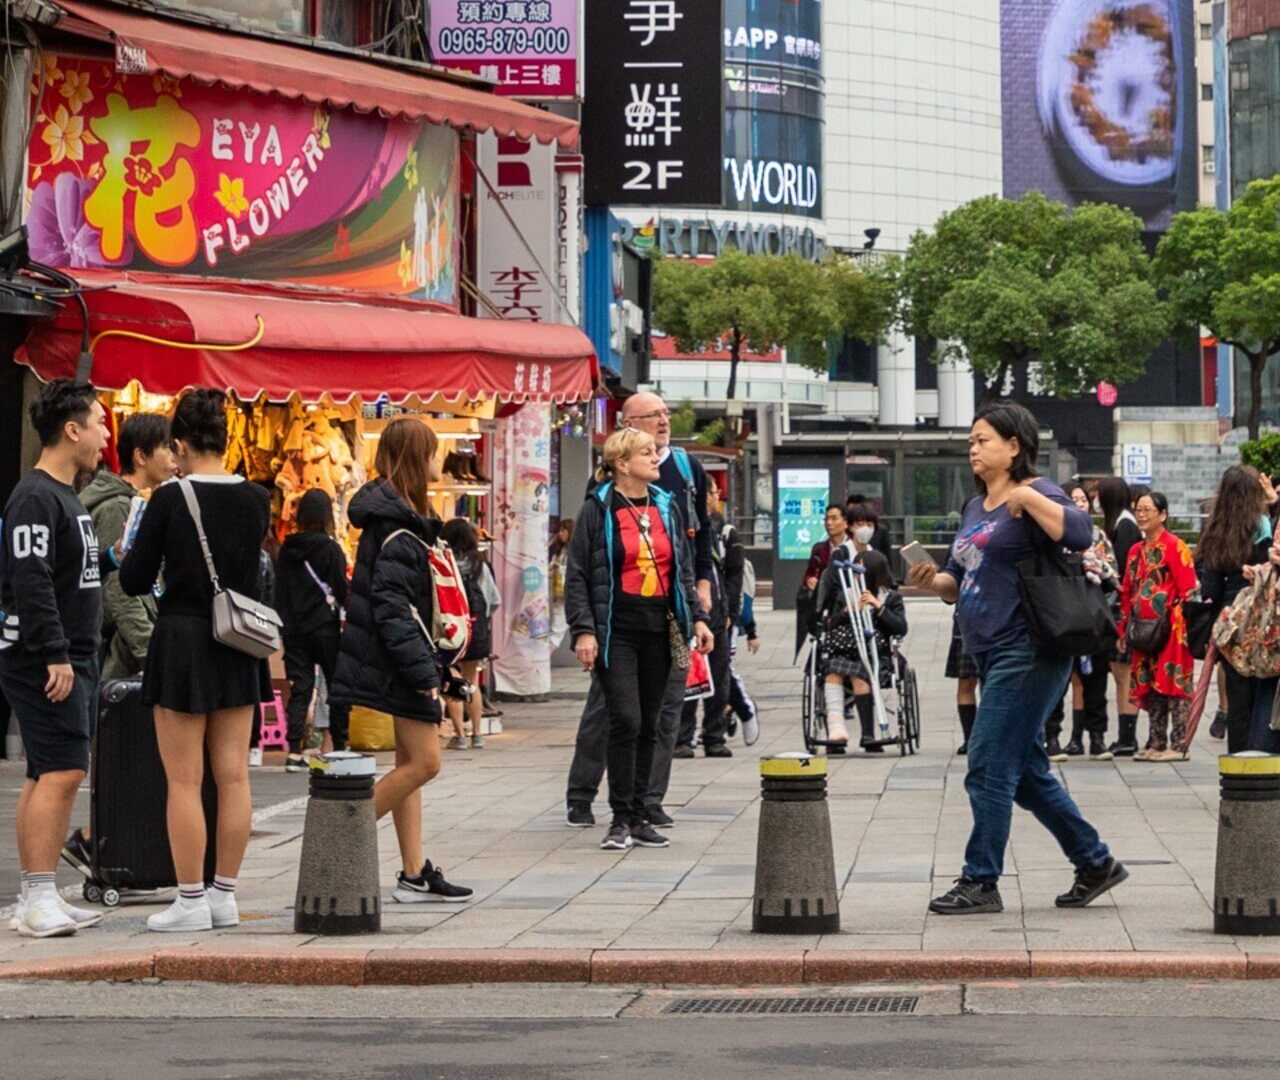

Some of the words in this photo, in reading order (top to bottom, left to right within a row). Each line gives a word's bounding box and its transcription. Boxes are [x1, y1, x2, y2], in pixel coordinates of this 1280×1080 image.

[457, 1, 551, 24] 預約專線
[439, 28, 569, 54] 0965-879-000
[212, 118, 282, 166] EYA
[87, 94, 200, 266] 花
[622, 160, 684, 190] 2F
[203, 131, 324, 266] FLOWER
[13, 524, 49, 559] 03
